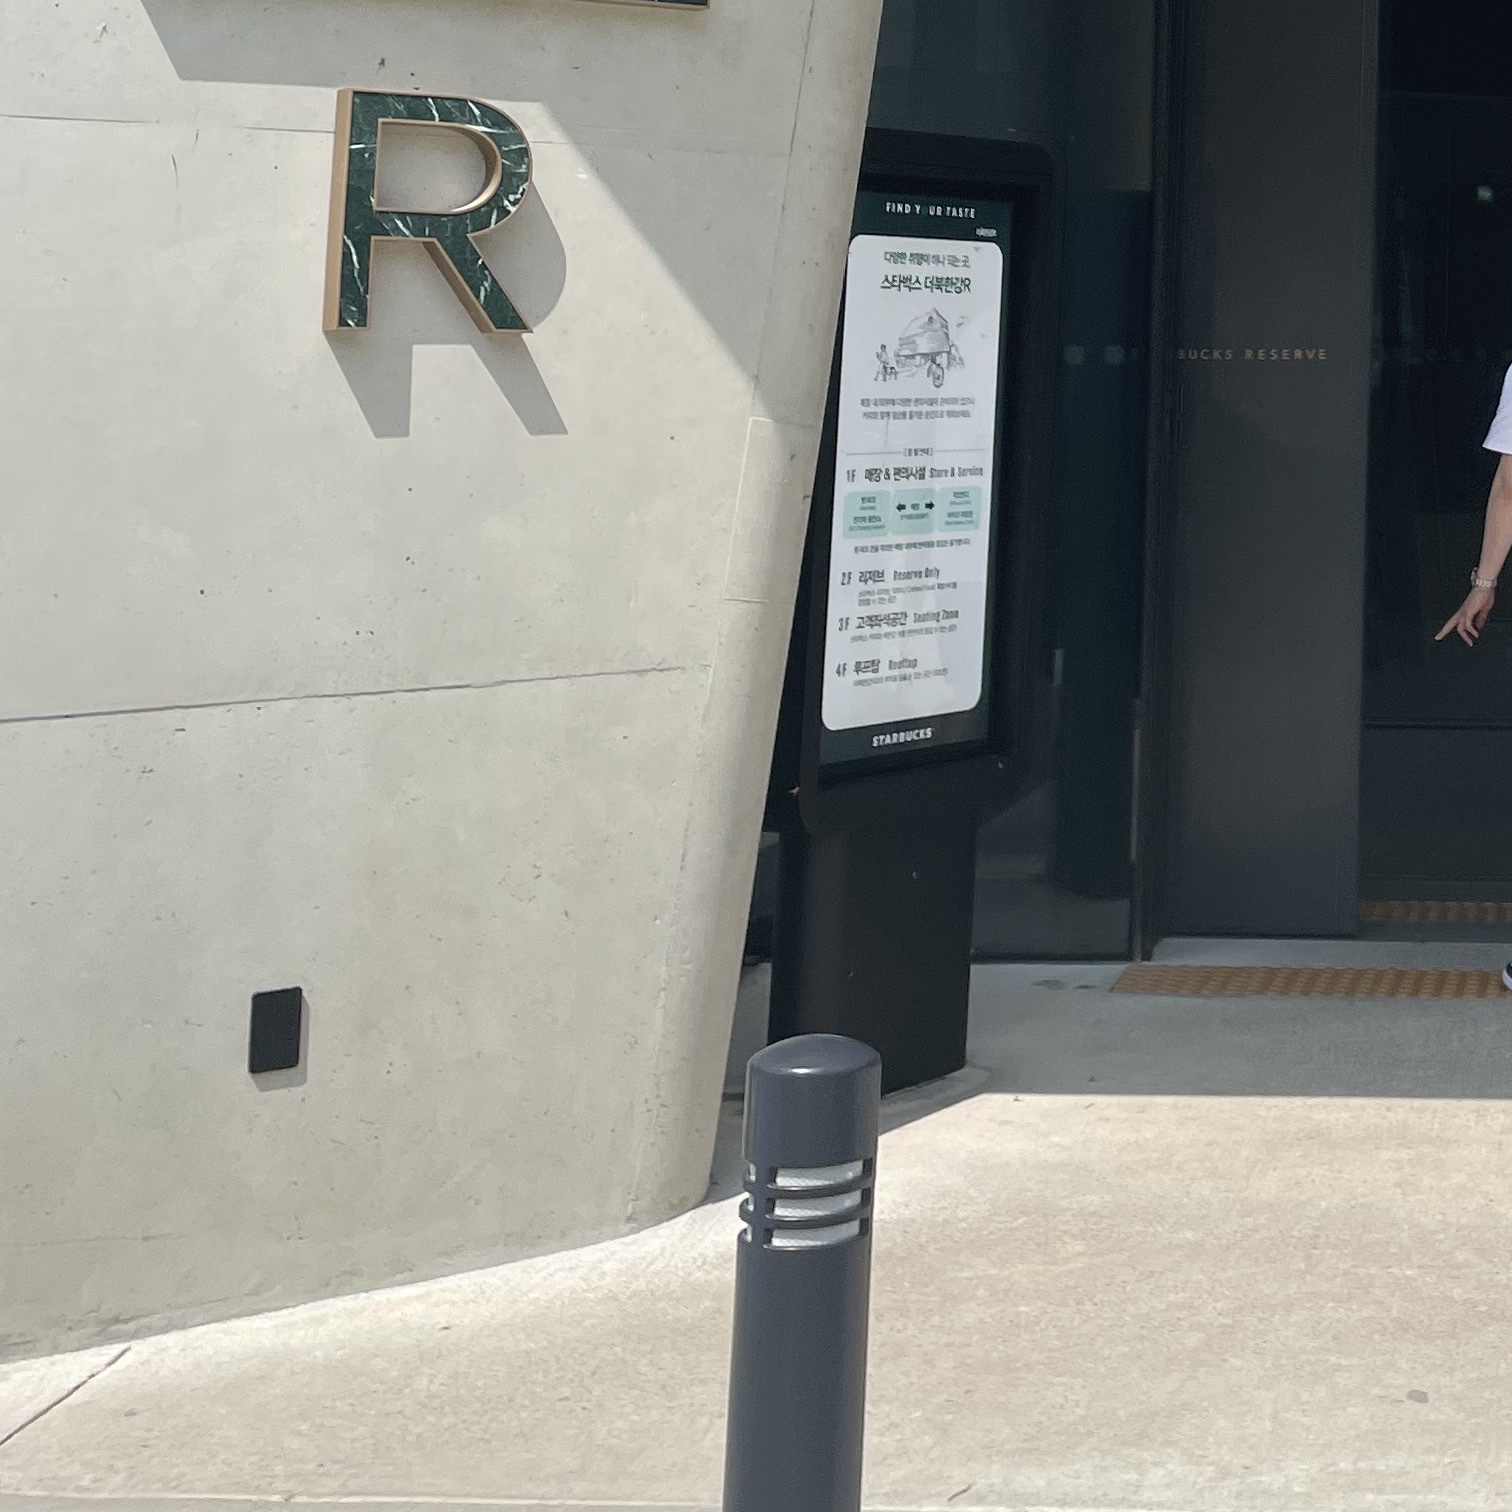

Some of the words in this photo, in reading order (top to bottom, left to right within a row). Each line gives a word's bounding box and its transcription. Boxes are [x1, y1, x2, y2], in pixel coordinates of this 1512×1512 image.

[323, 88, 534, 334] R
[885, 201, 911, 214] FIND
[914, 203, 943, 217] YUR
[945, 206, 976, 219] TASTE
[880, 274, 923, 293] 스타벅스
[924, 276, 972, 295] 더북한강R
[1243, 348, 1327, 360] RESERVE
[871, 727, 933, 747] STARBUCKS
